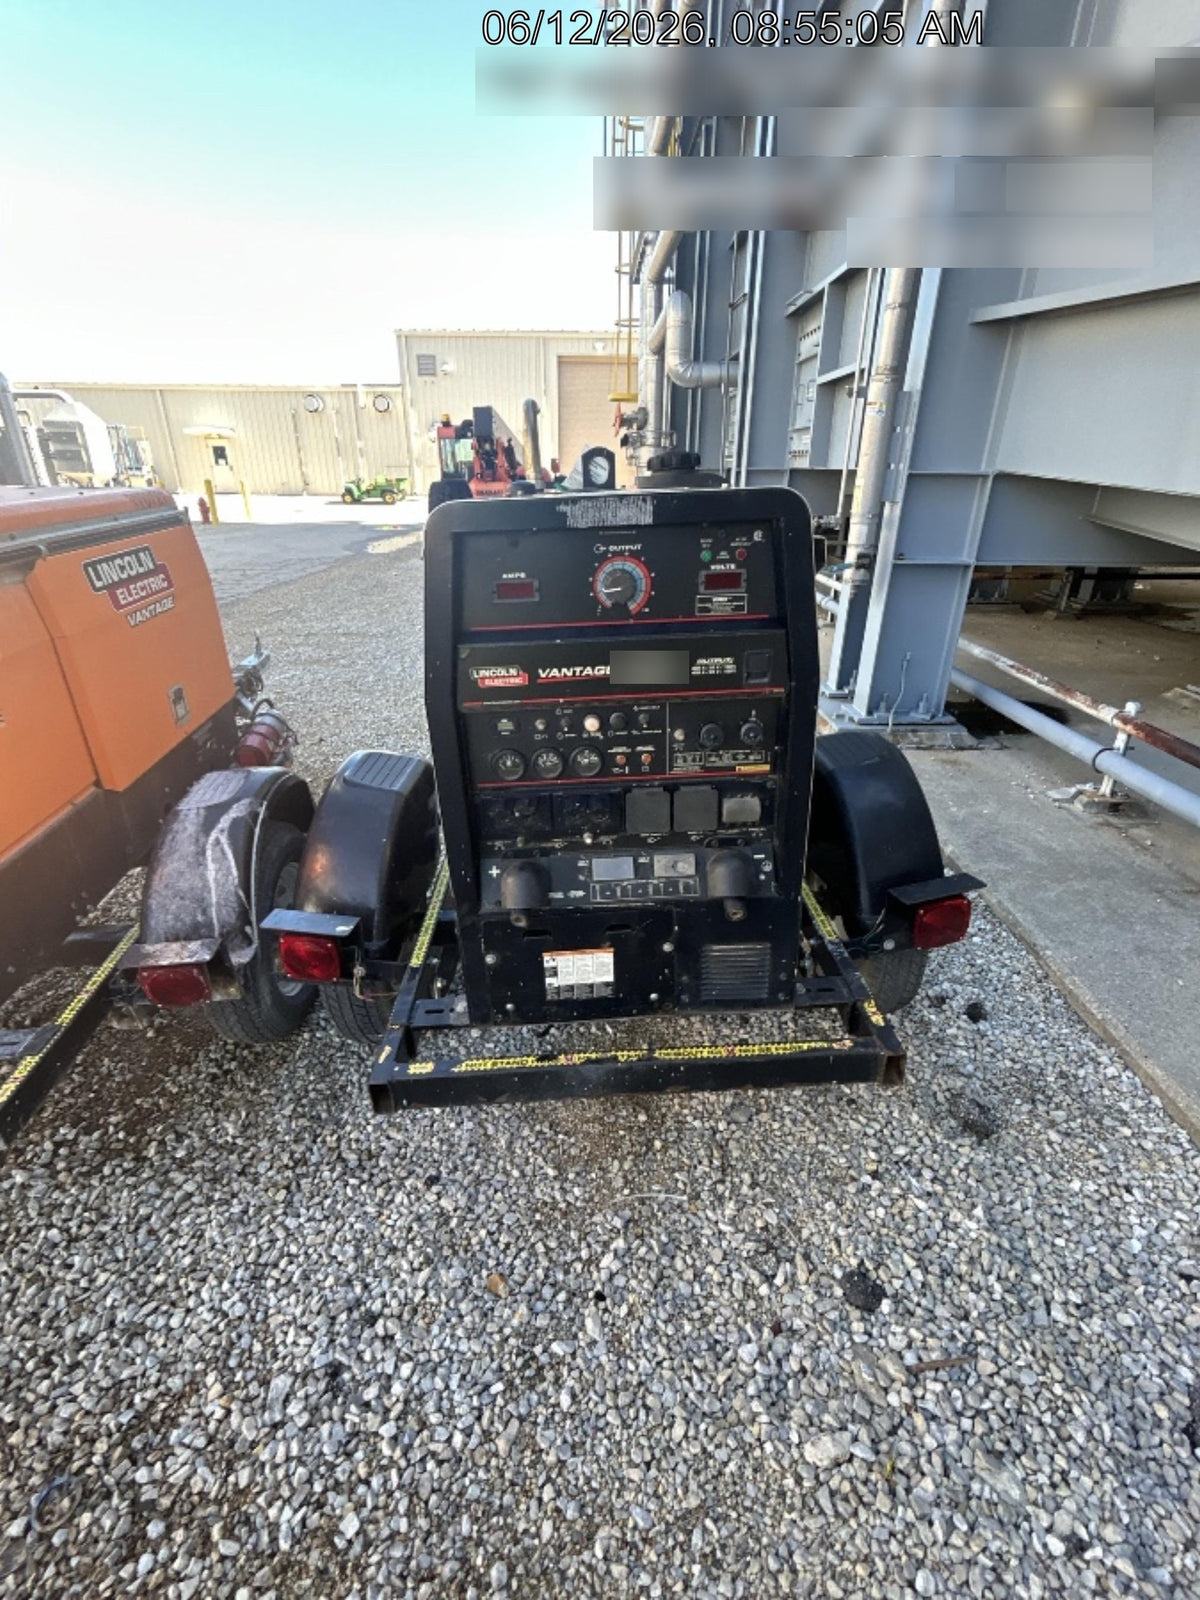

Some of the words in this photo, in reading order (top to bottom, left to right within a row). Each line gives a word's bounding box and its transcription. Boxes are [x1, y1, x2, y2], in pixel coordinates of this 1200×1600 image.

[607, 543, 643, 552] OUTPUT
[88, 550, 155, 588] LINCOLN
[116, 573, 168, 605] ELECTRIC
[126, 596, 174, 627] VANTAGE
[472, 667, 518, 679] LINCOLN
[484, 677, 524, 686] ELECTRIC
